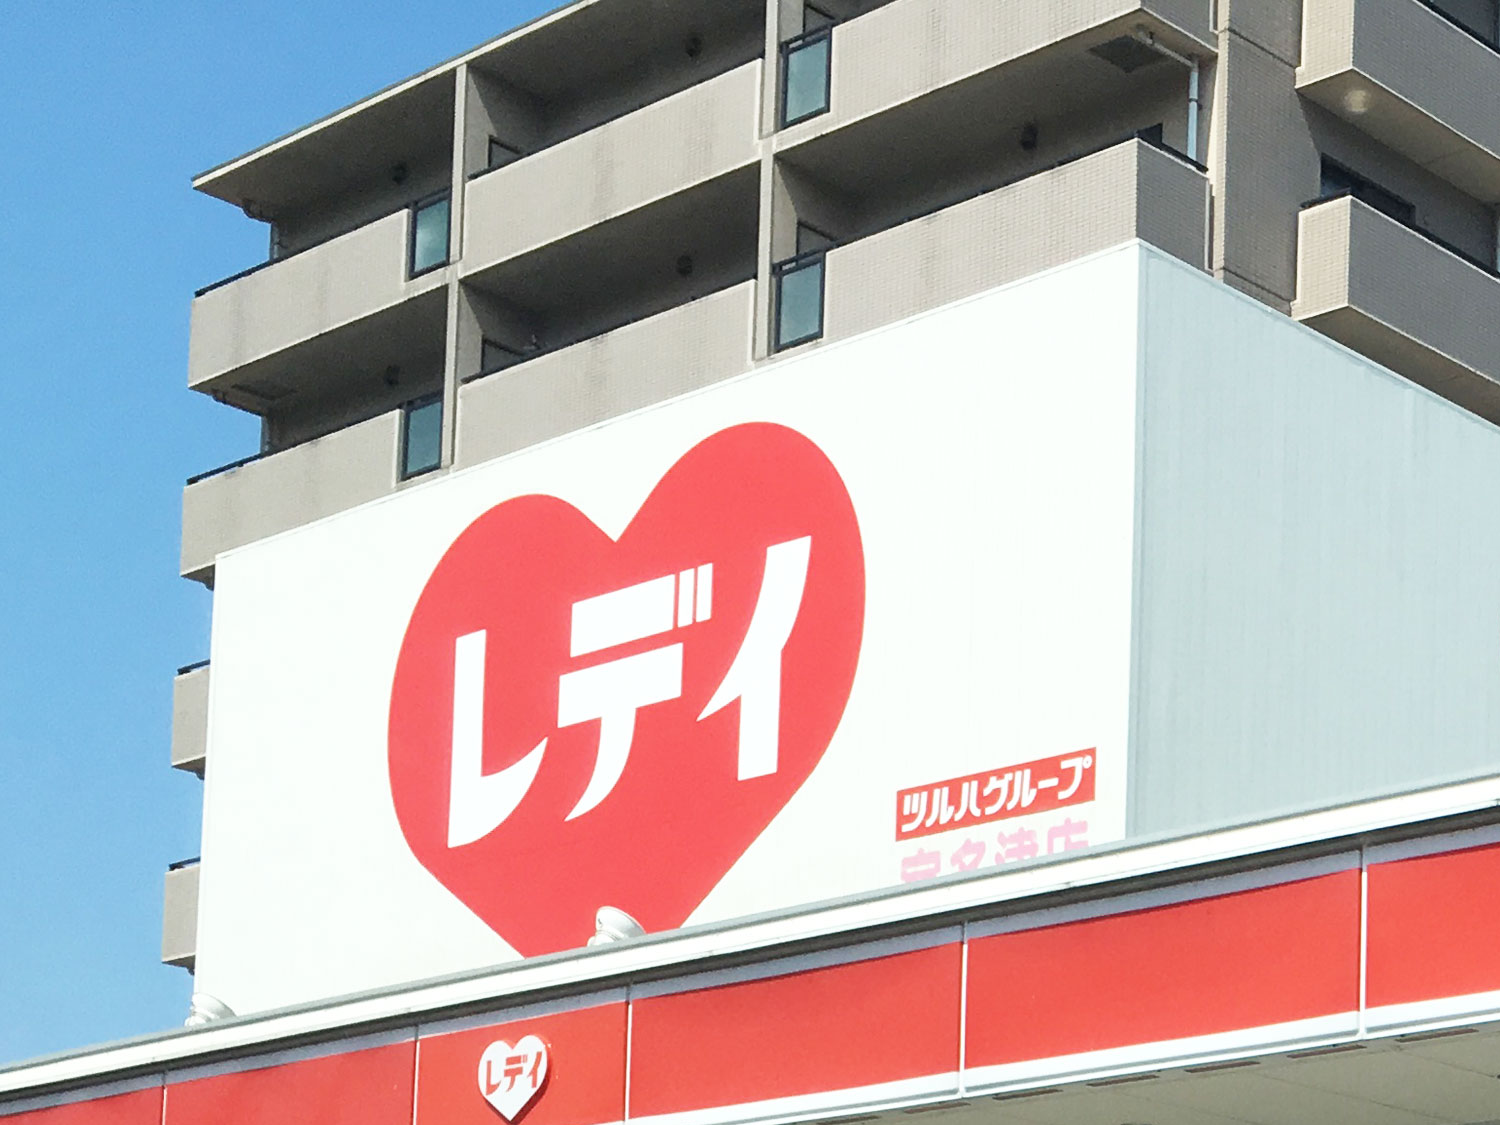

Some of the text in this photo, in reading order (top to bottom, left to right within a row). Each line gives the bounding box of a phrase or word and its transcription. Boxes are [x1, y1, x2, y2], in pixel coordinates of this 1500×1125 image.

[901, 755, 1093, 832] ツルハグループ
